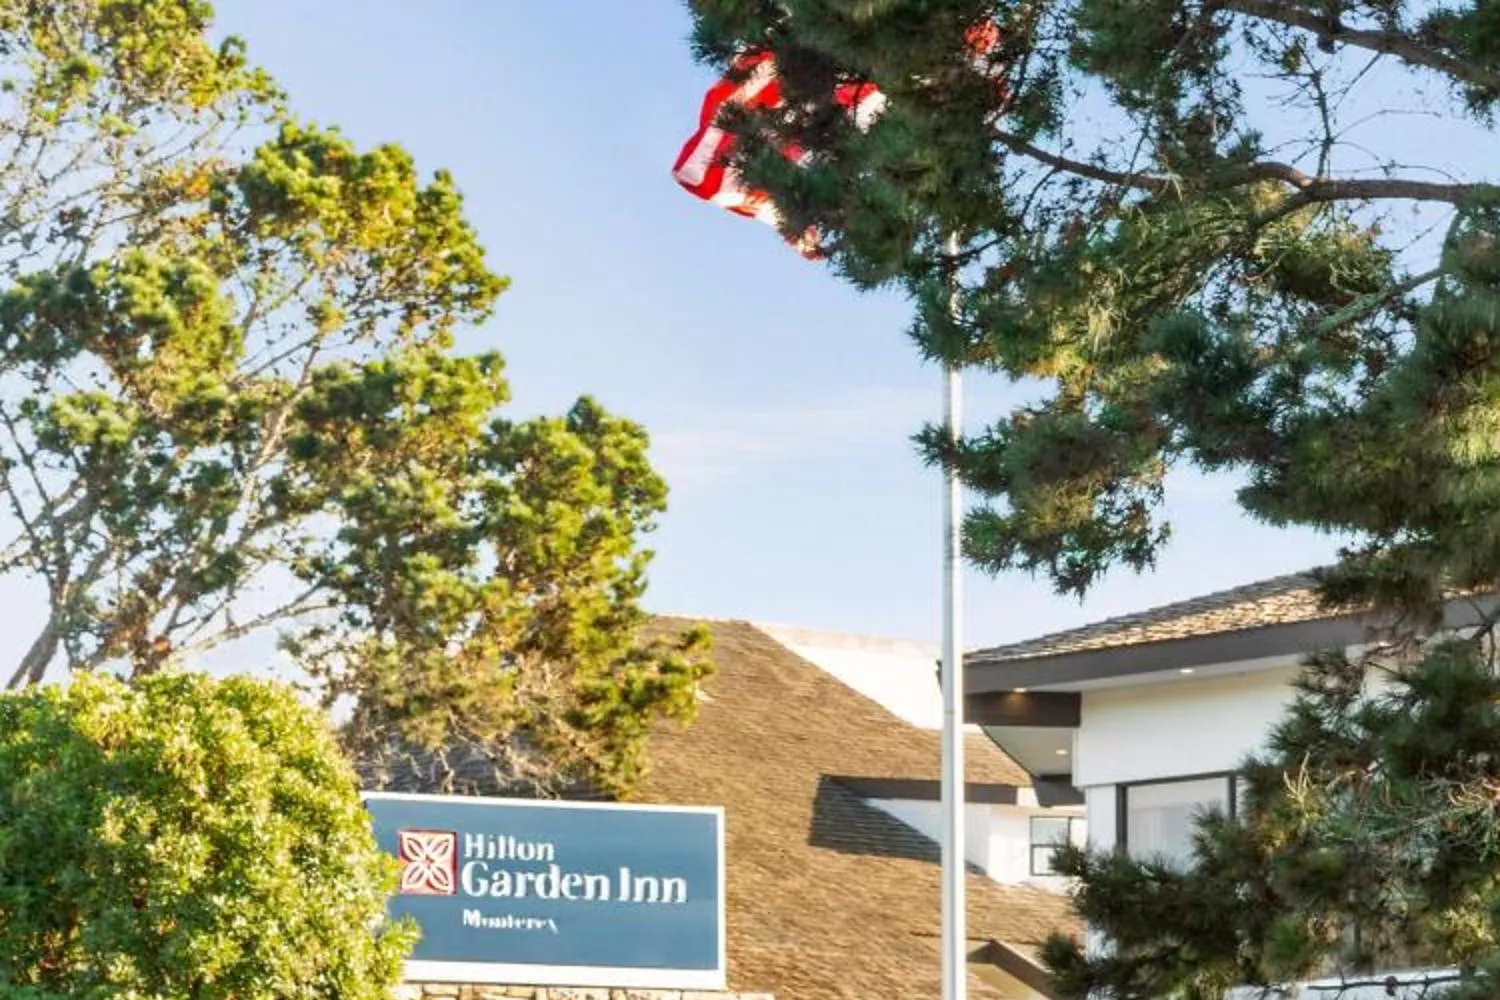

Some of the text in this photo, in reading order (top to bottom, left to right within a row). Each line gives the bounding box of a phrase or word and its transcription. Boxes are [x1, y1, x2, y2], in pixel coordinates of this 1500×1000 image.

[464, 833, 555, 862] Hilton
[461, 861, 688, 904] Garden Inn
